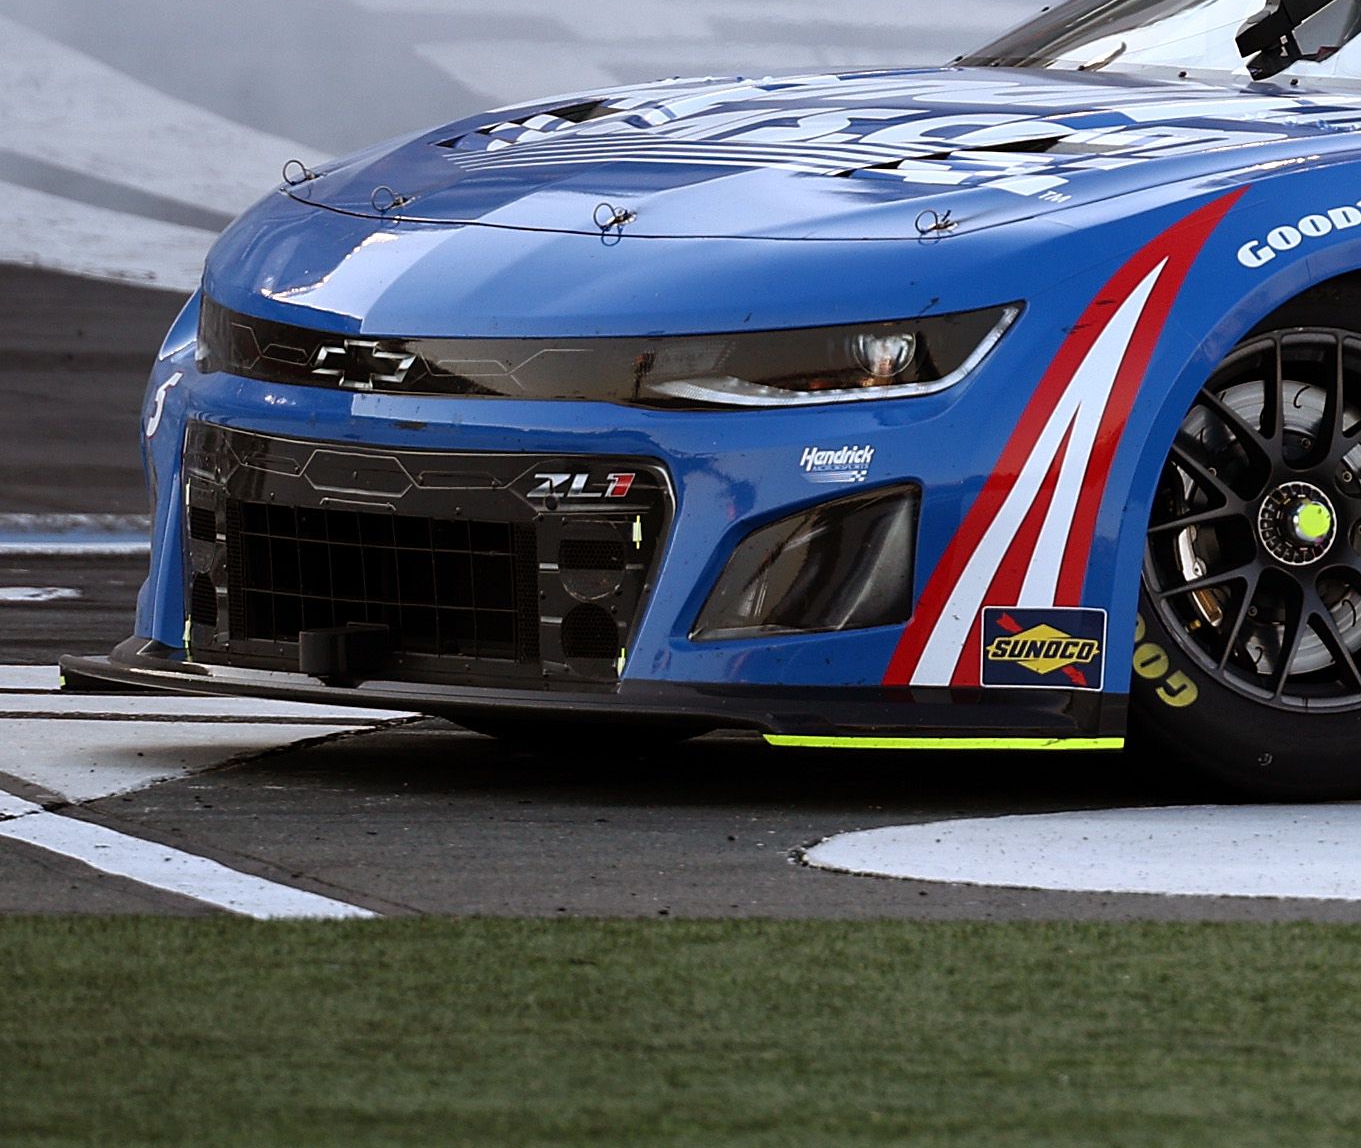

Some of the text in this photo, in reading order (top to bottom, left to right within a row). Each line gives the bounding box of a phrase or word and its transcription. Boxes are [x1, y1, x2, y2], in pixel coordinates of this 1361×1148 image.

[800, 445, 875, 472] Hendrick
[526, 473, 636, 498] ZL1
[990, 639, 1095, 660] SUNOCO
